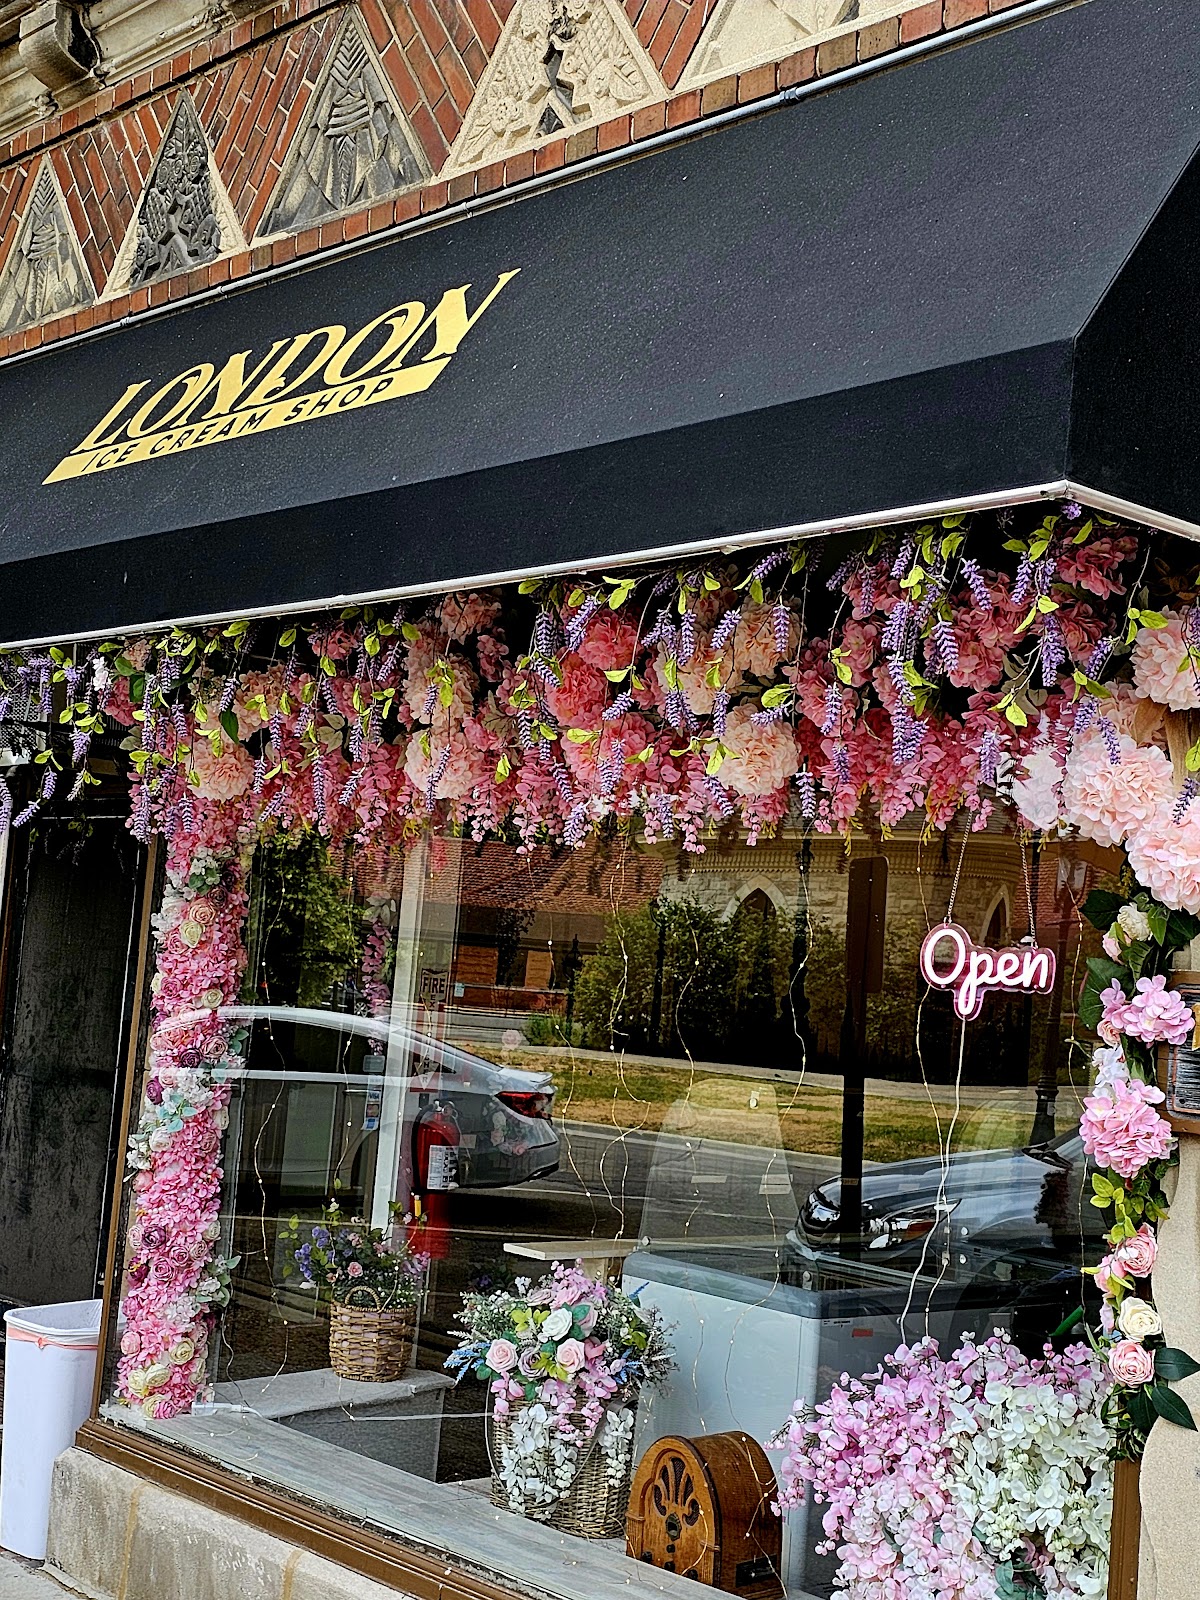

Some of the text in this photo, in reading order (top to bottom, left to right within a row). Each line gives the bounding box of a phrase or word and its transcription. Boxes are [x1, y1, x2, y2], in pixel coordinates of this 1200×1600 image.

[70, 267, 523, 454] LONDON
[80, 377, 395, 473] ICE CREAM SHOP
[421, 977, 446, 994] FIRE
[924, 928, 1049, 1016] Open
